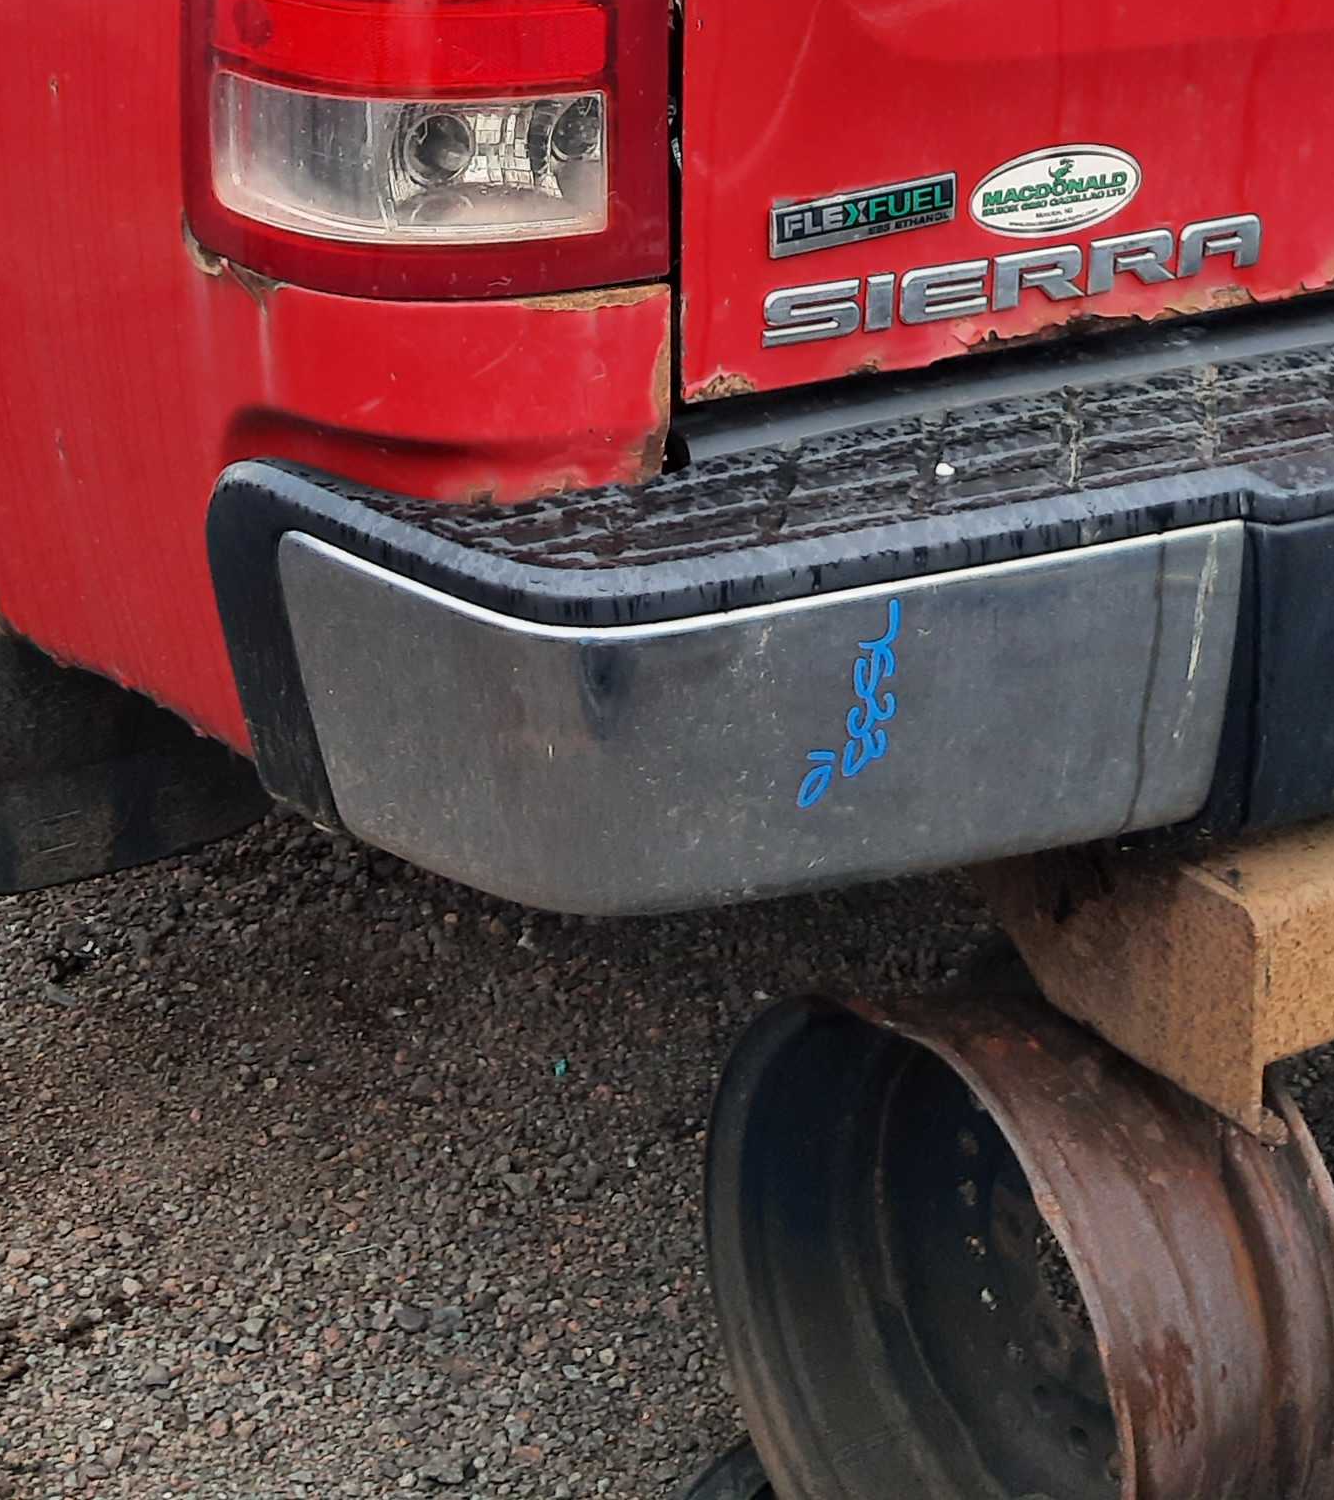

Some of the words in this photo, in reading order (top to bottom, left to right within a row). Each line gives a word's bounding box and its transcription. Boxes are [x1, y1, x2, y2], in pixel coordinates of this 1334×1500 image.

[981, 171, 1128, 207] MACDONALD
[894, 211, 950, 230] ETHANOL
[762, 213, 1262, 348] SIERRA
